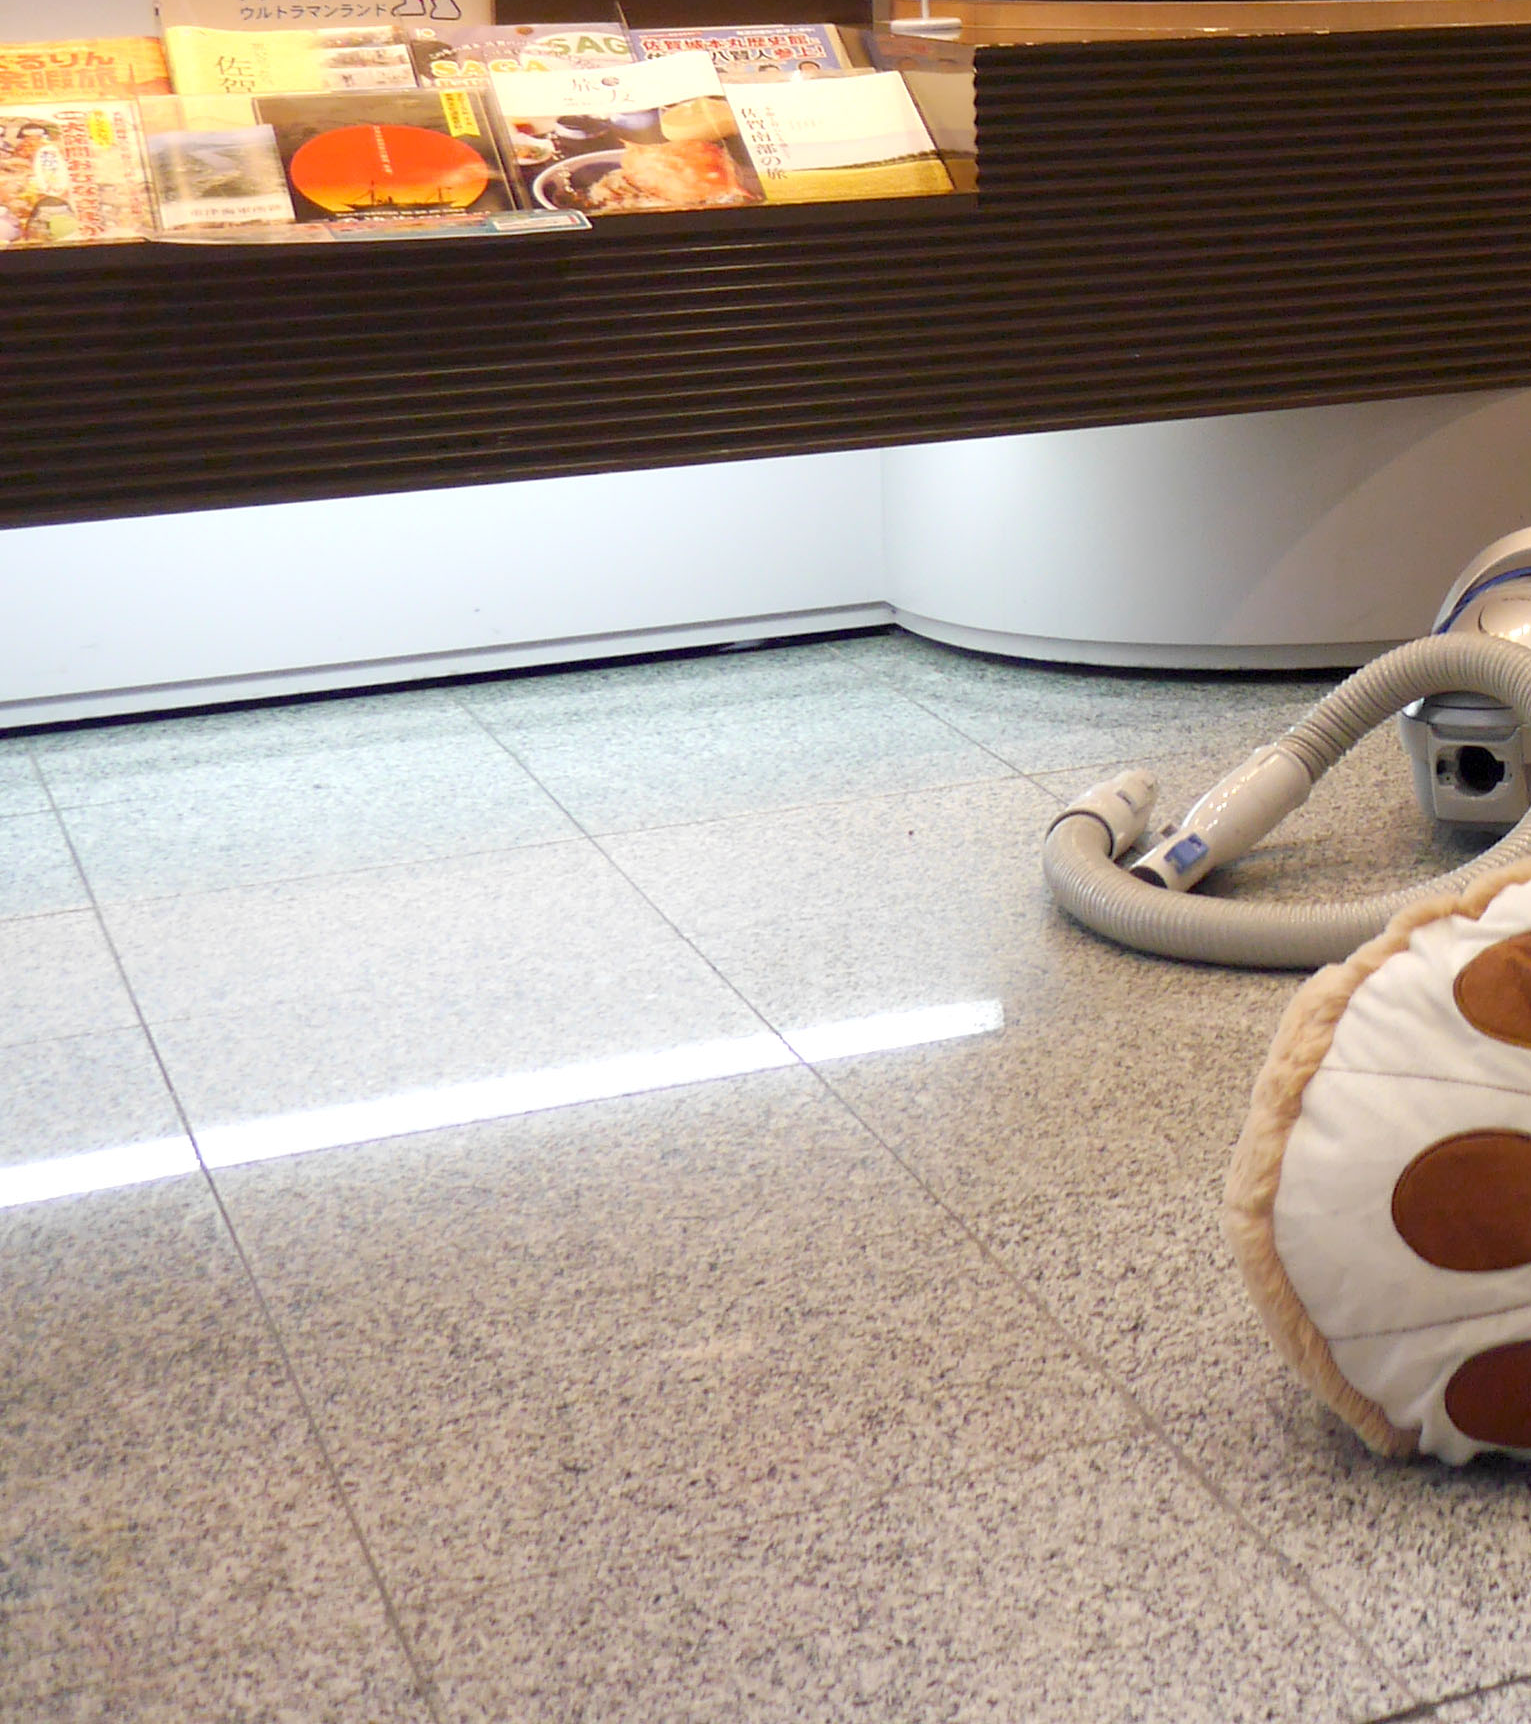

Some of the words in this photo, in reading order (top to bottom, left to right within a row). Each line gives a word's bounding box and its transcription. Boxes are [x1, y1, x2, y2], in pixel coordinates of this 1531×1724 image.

[239, 2, 387, 21] ウルトラマンランド
[430, 59, 550, 79] SAGA
